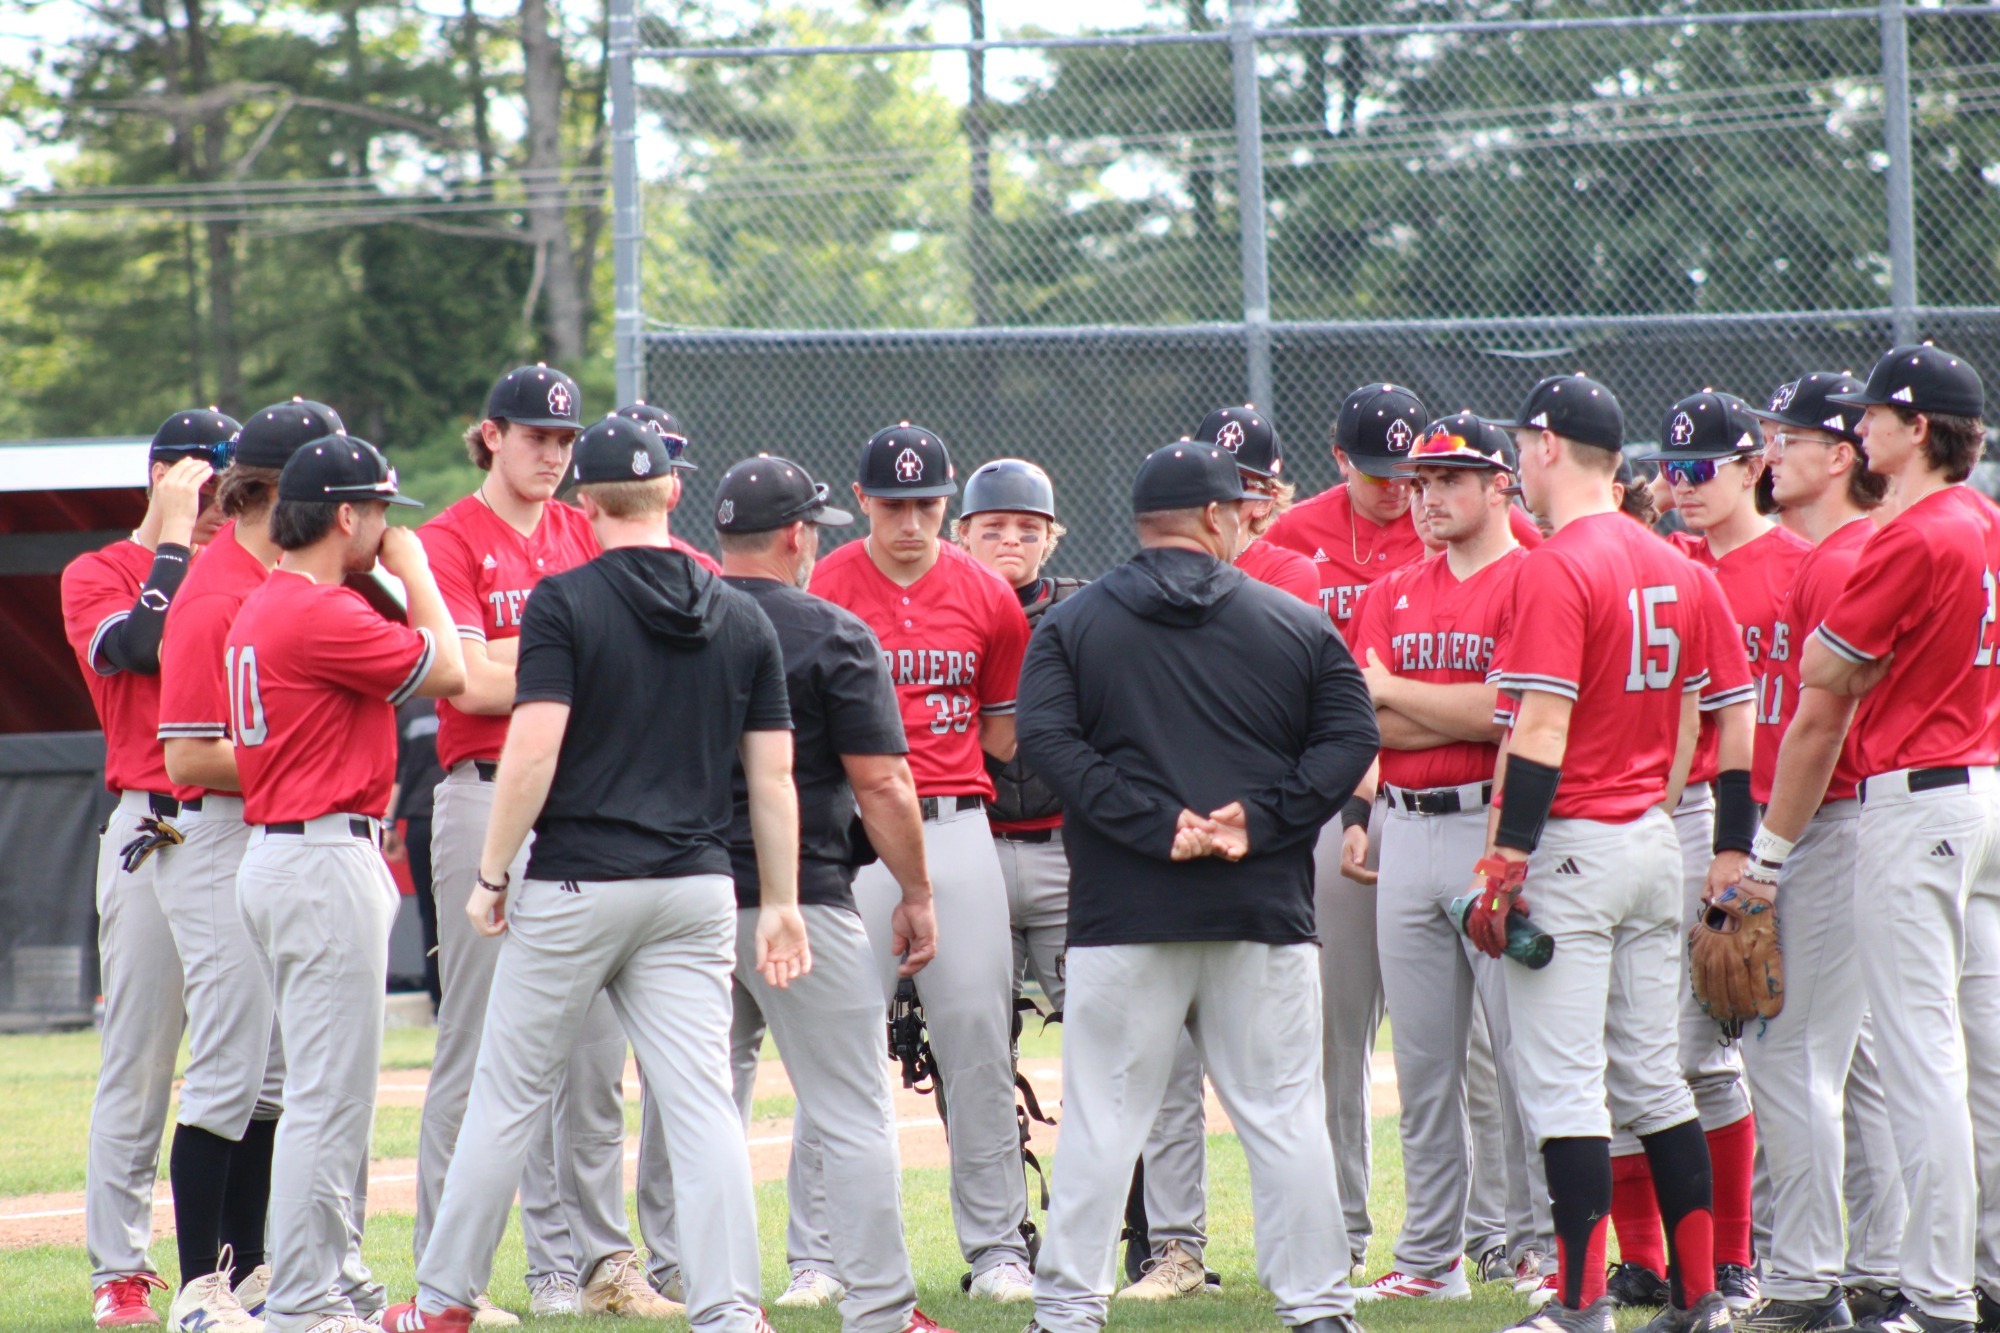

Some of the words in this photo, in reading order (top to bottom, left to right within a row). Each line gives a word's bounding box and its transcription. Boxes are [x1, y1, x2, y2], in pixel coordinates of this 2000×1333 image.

[555, 395, 567, 410] T
[1224, 432, 1237, 447] T
[1393, 432, 1406, 447] T
[1675, 425, 1686, 440] T
[902, 462, 915, 477] T
[1974, 563, 2000, 666] 2
[1625, 585, 1681, 692] 15
[225, 646, 268, 747] 10
